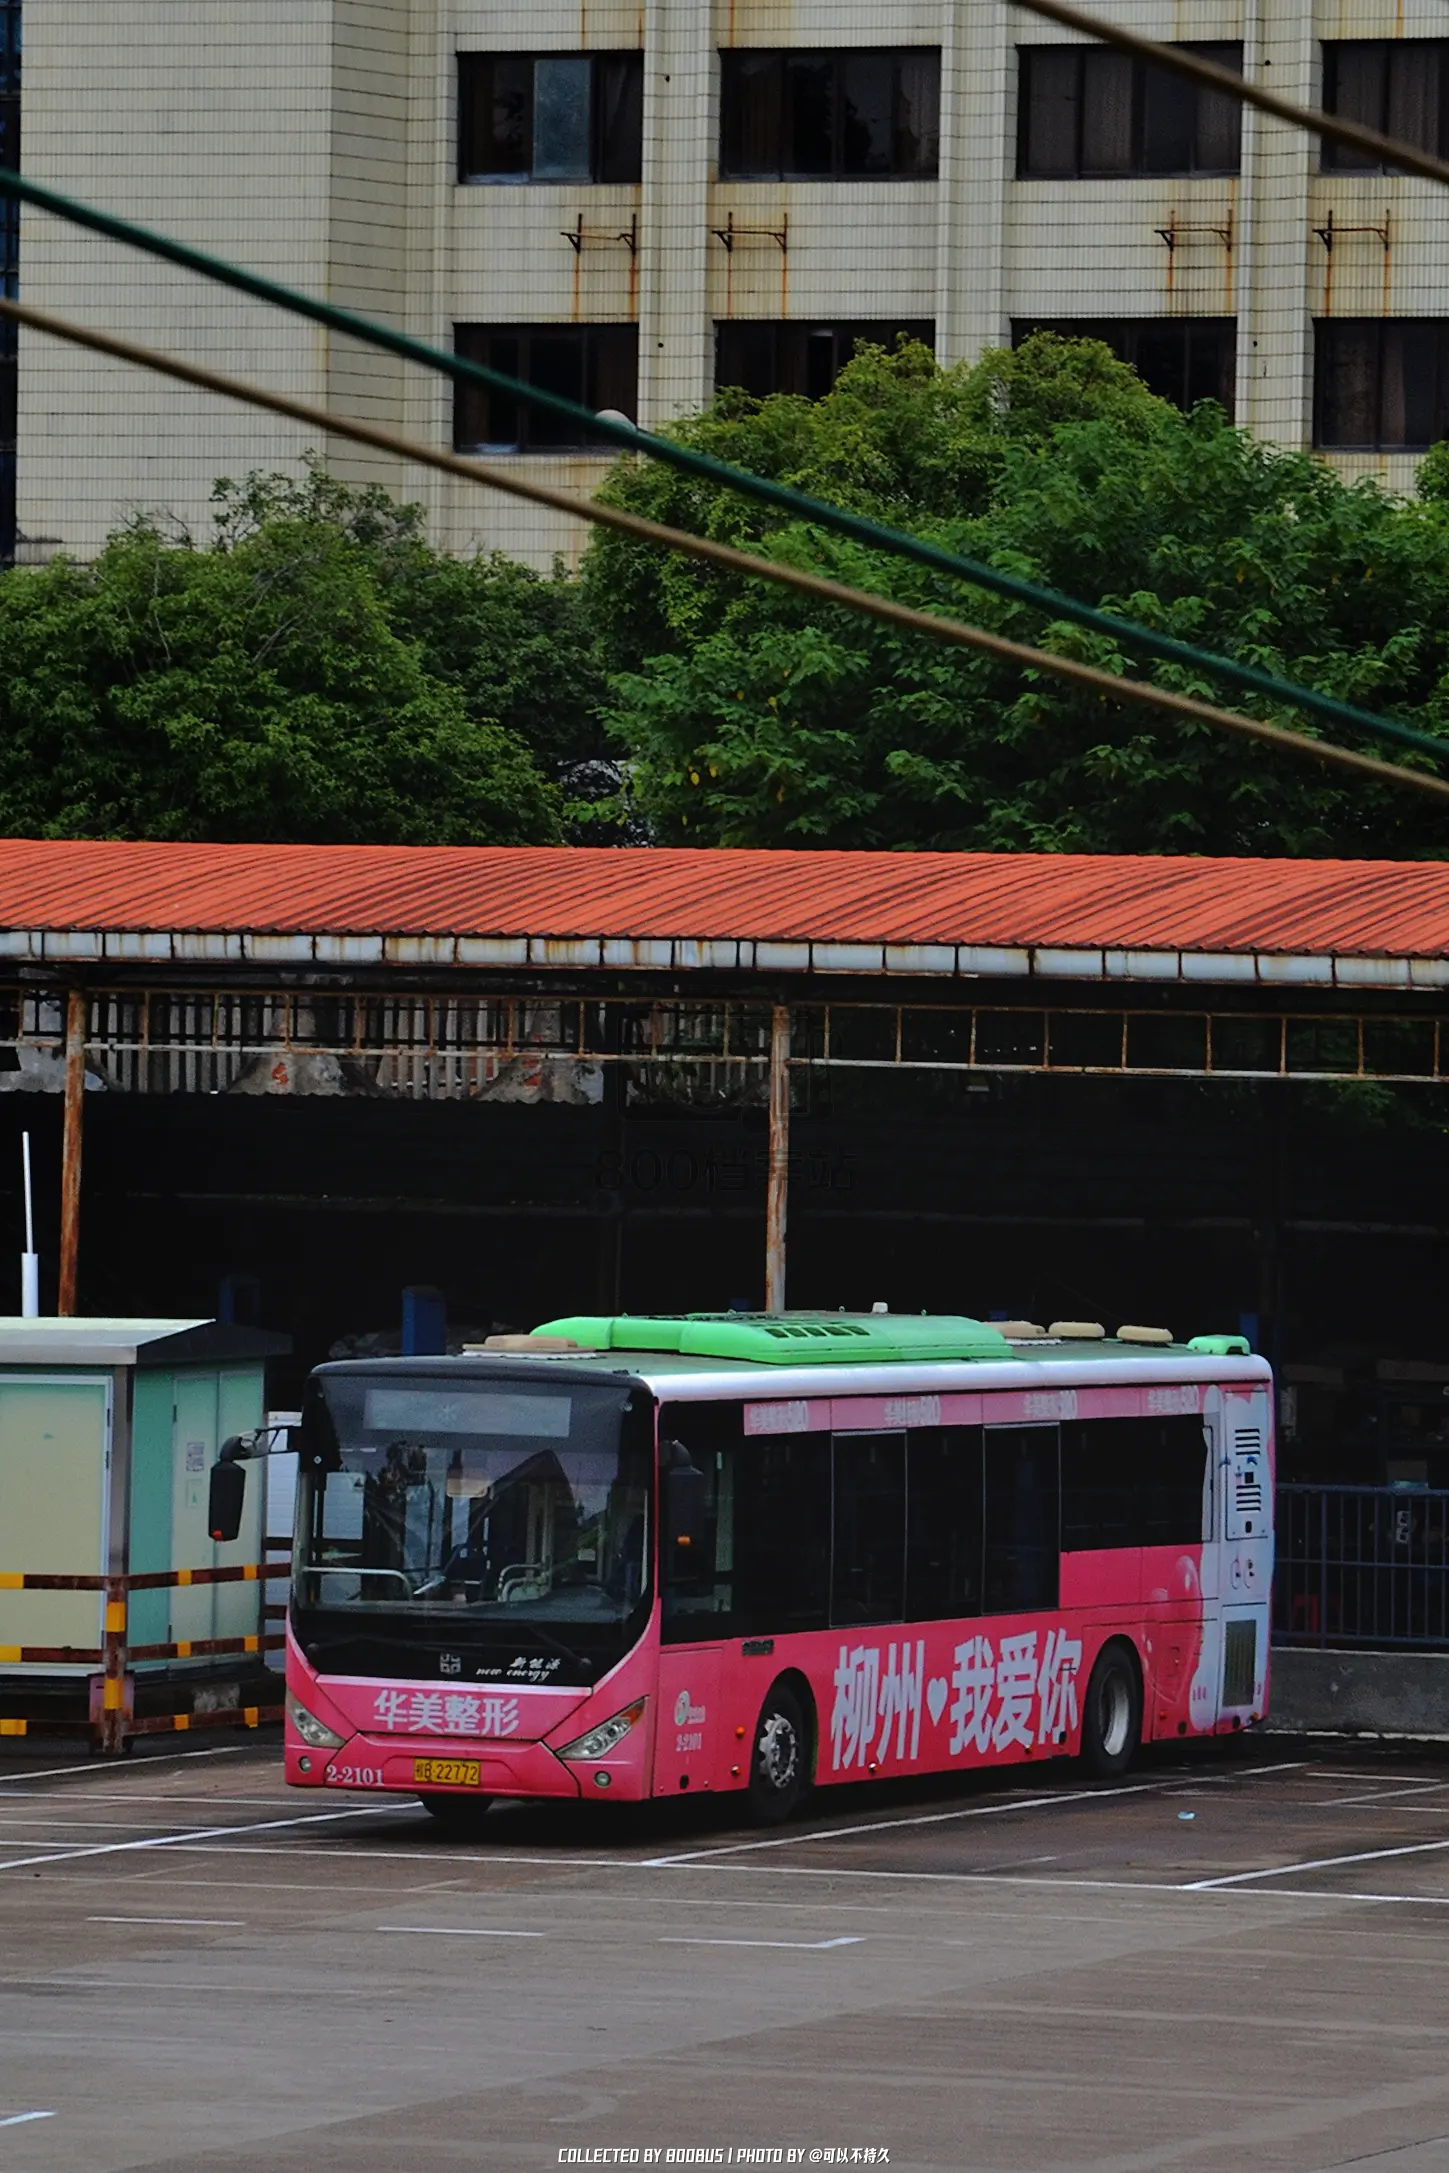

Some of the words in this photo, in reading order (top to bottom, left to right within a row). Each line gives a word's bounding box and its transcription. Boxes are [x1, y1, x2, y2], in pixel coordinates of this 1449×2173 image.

[475, 1667, 502, 1676] new
[506, 1668, 551, 1683] energy
[372, 1688, 520, 1737] 华美整形
[830, 1639, 925, 1772] 柳州
[949, 1628, 1083, 1756] 我爱你
[325, 1763, 385, 1786] 2-2101
